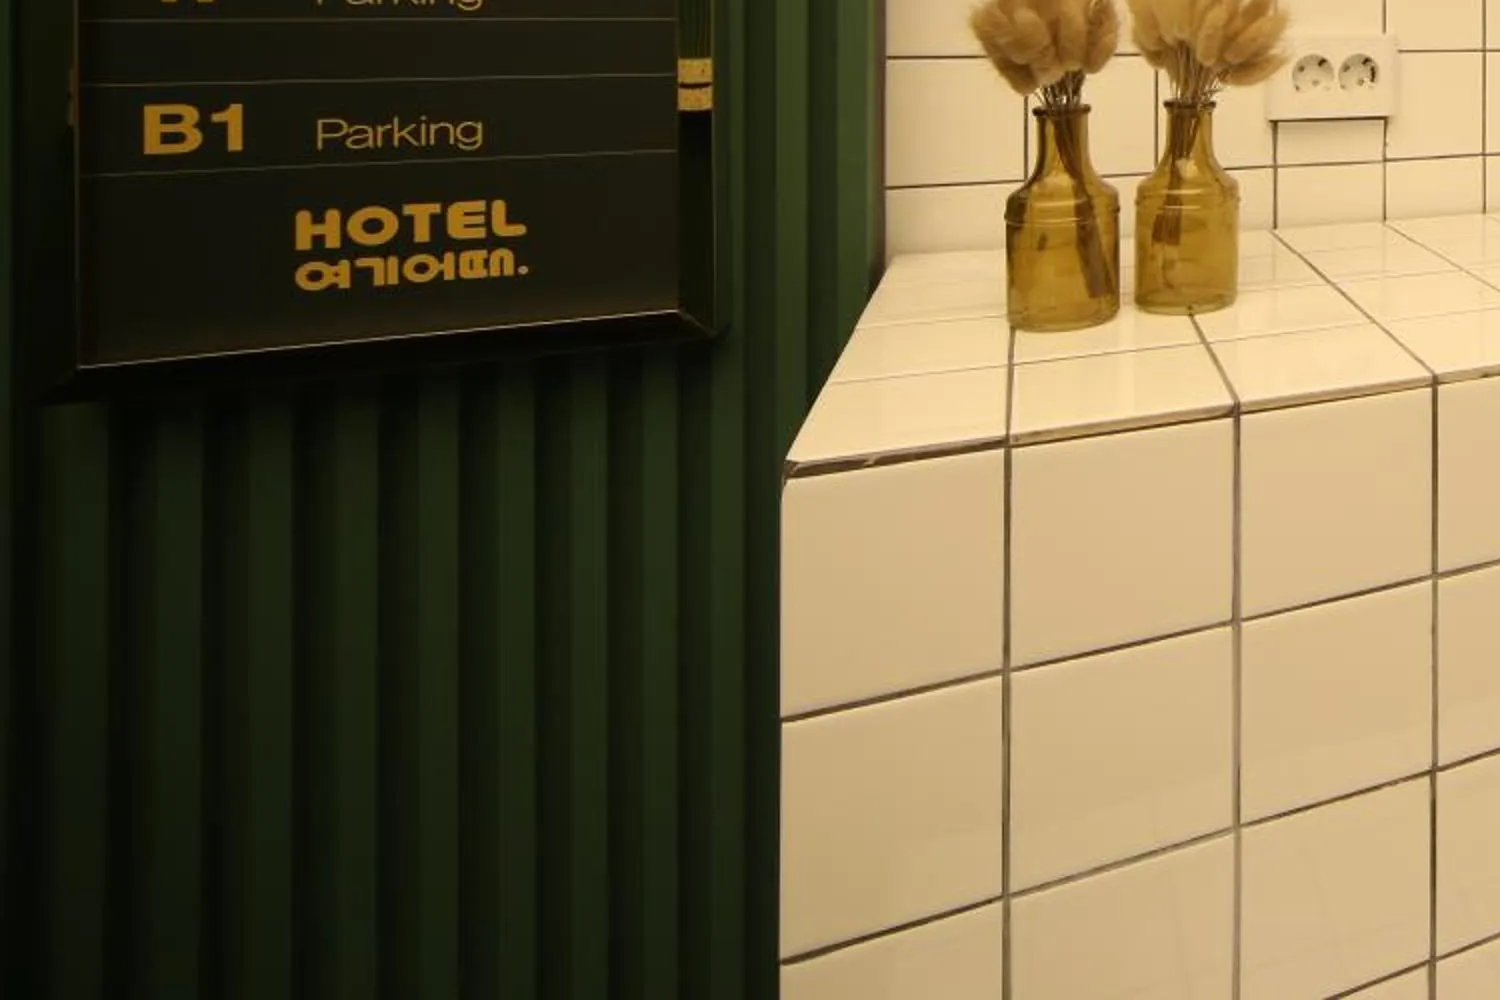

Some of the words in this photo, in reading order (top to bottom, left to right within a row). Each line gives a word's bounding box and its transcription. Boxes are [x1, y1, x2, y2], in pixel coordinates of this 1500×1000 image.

[144, 104, 243, 154] B1
[317, 117, 482, 150] Parking
[295, 199, 527, 251] HOTEL
